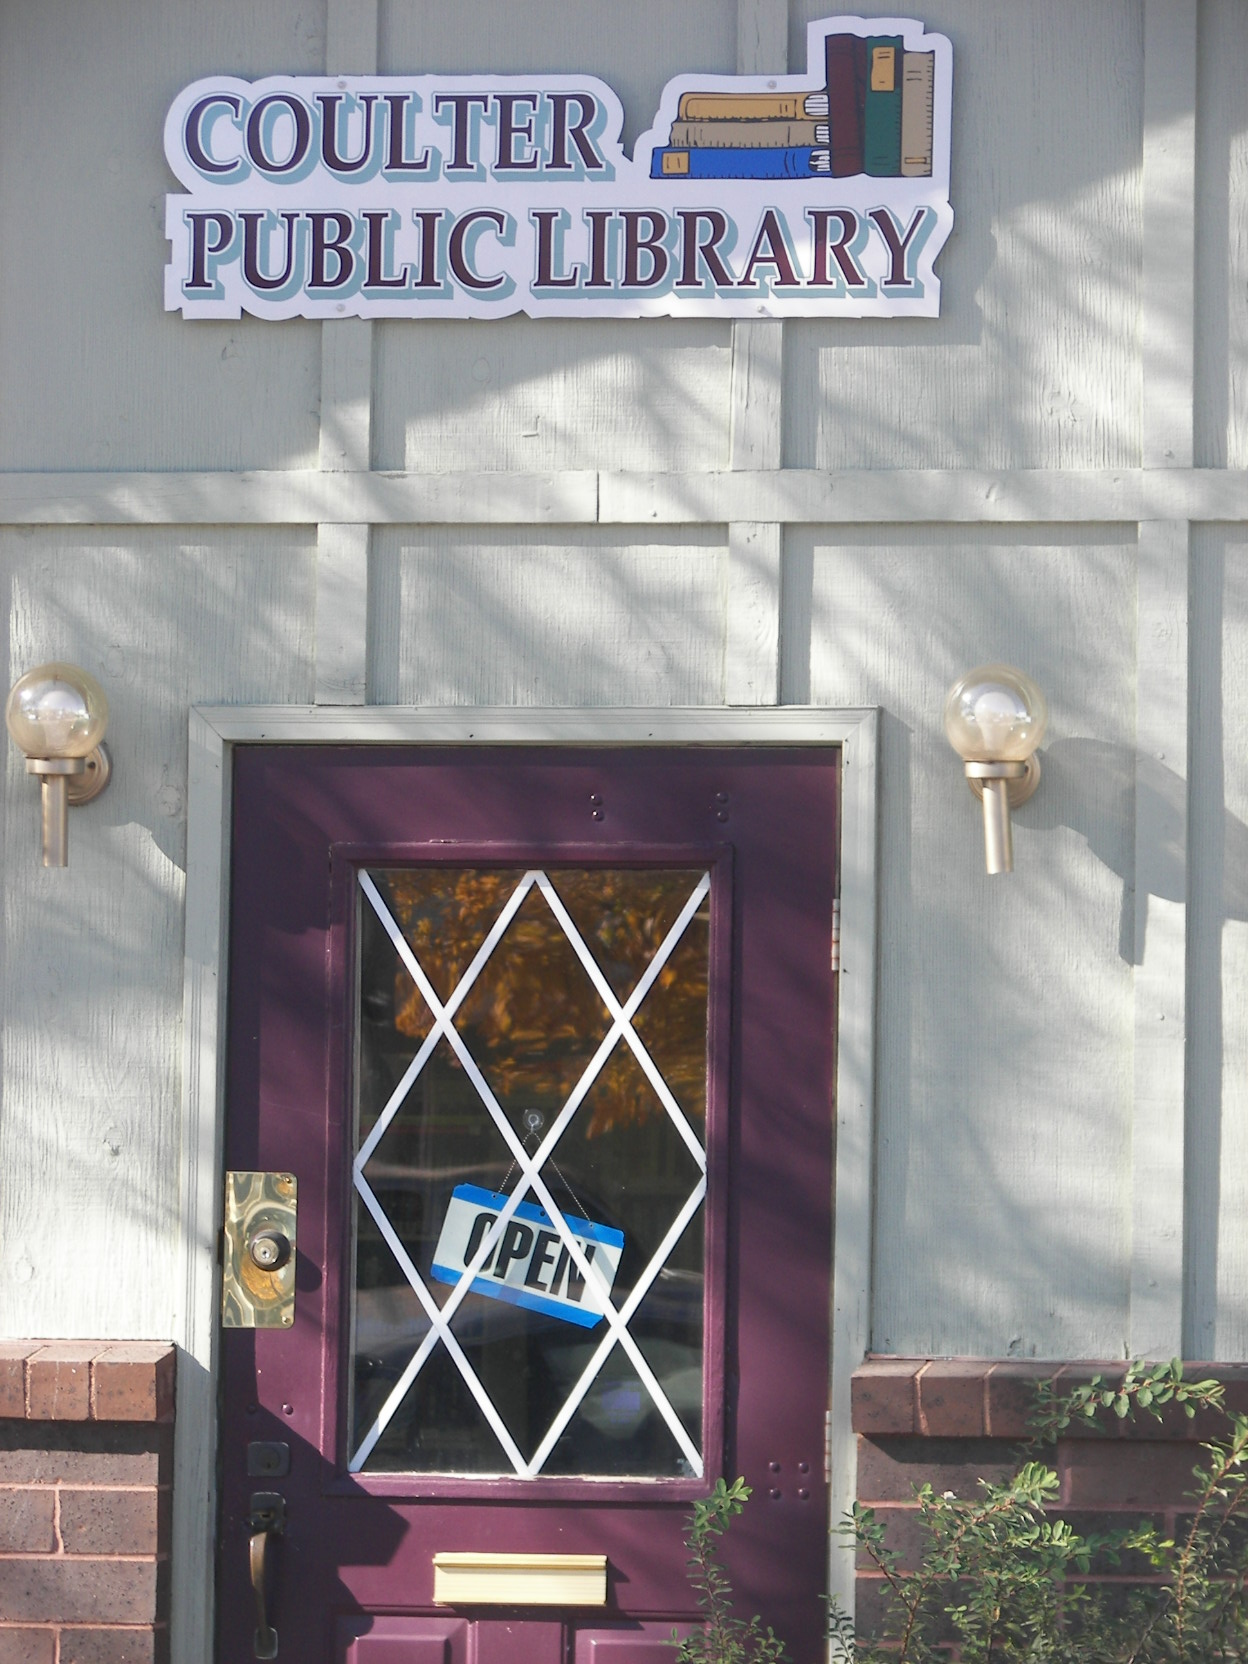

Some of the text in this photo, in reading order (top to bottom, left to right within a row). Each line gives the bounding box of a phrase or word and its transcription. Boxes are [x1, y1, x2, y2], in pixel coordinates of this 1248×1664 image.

[184, 93, 606, 174] COULTER
[184, 208, 928, 290] PUBLIC LIBRARY
[463, 1212, 596, 1302] OPEN
